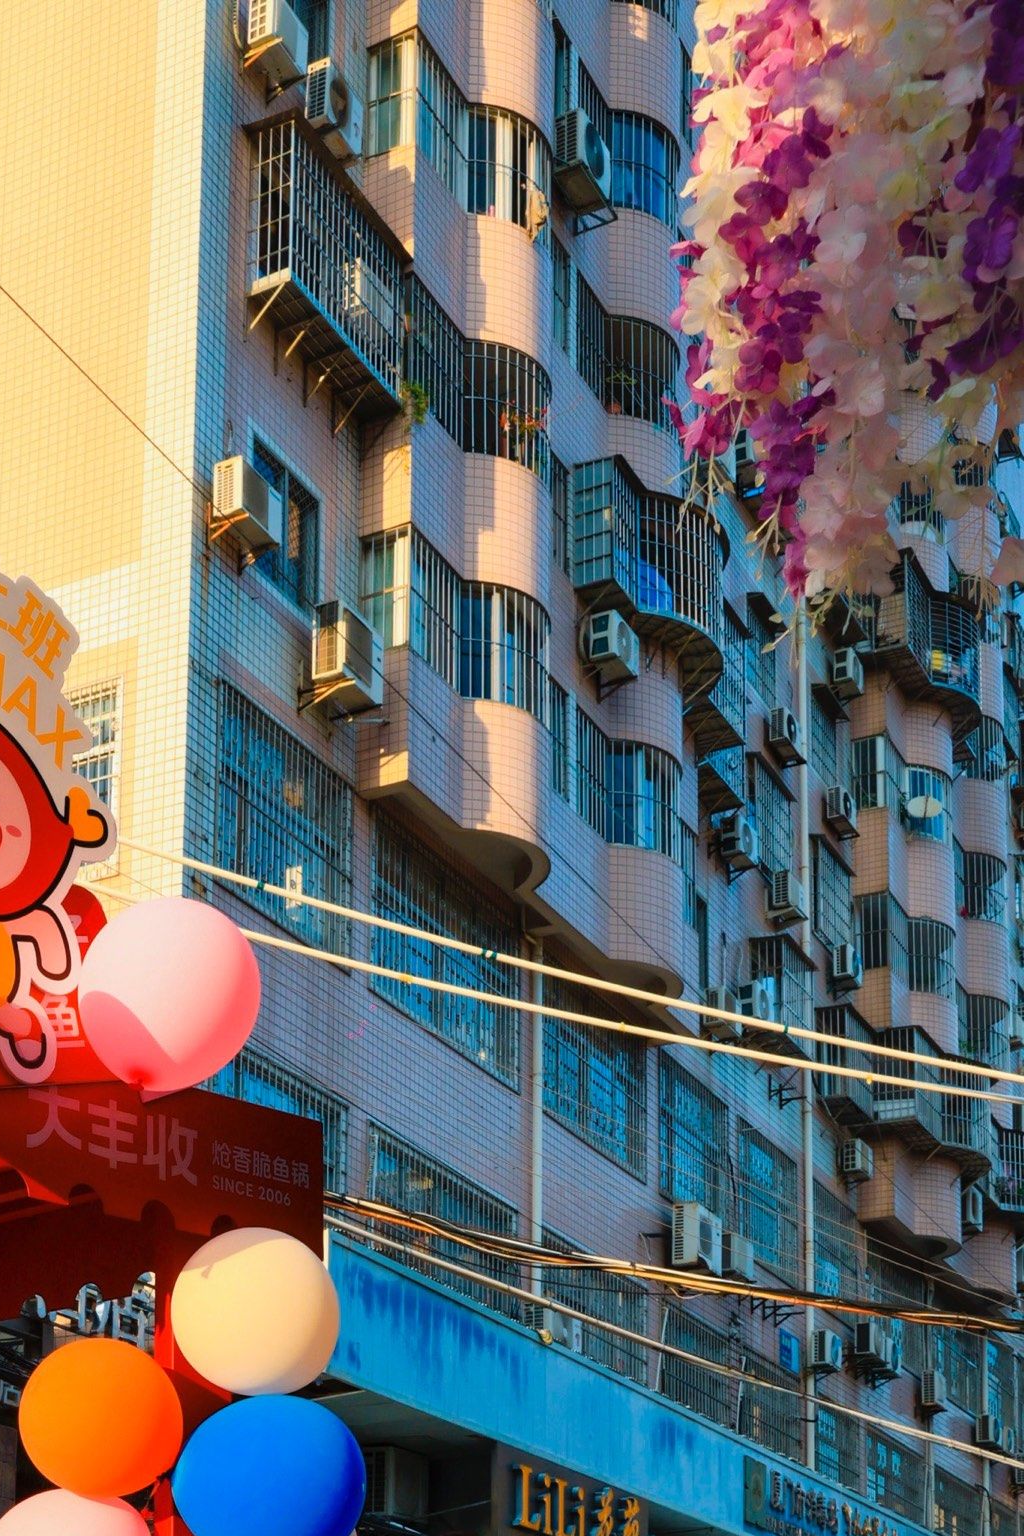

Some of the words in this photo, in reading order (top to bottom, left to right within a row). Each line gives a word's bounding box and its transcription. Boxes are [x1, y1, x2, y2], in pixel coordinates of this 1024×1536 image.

[26, 1086, 198, 1187] 大丰收
[212, 1176, 254, 1198] SINCE
[258, 1186, 292, 1207] 2006
